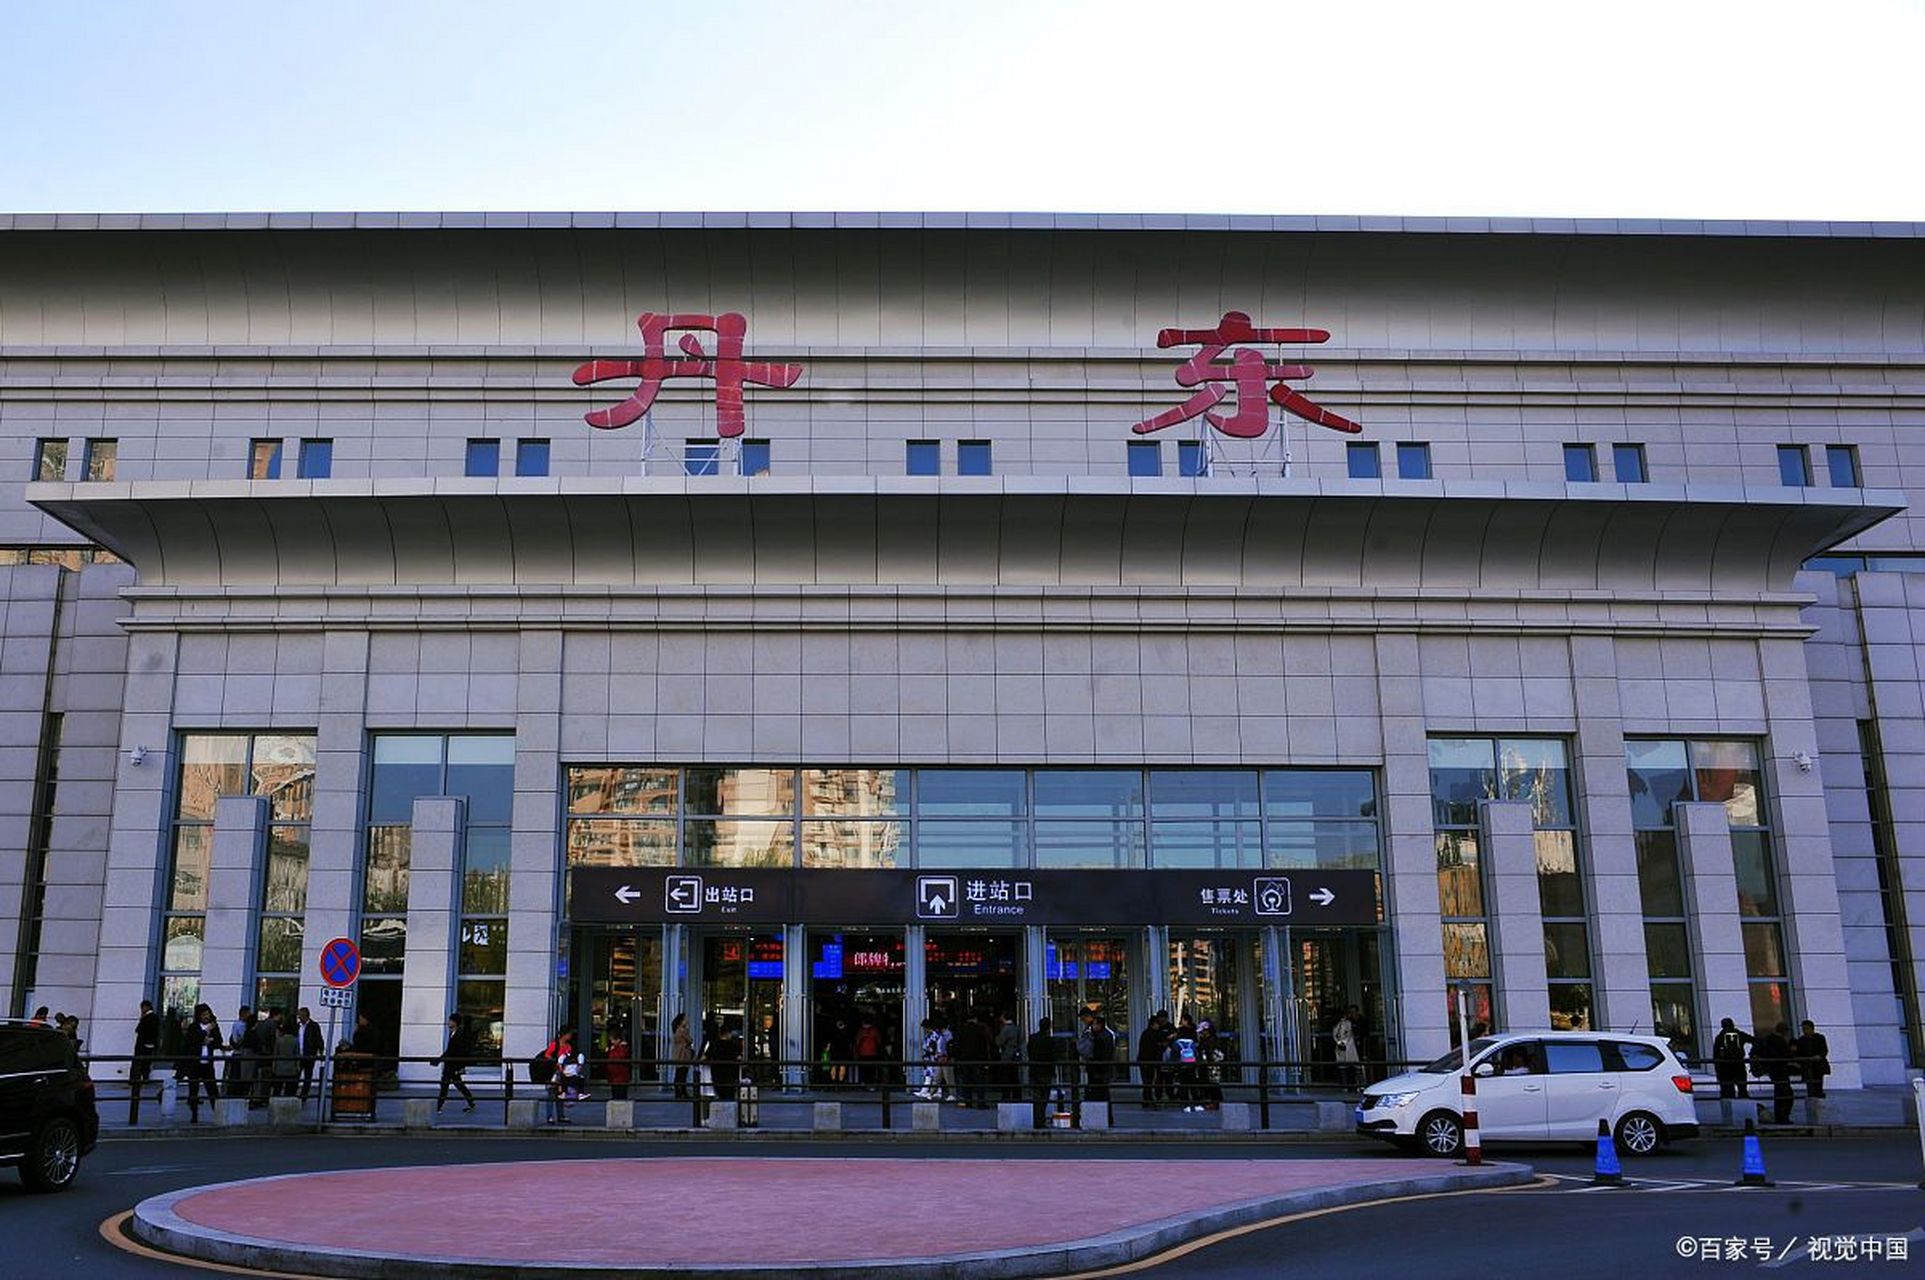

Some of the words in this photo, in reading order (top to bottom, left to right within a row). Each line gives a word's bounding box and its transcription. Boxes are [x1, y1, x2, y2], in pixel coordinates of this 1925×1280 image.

[705, 886, 754, 903] 出站口
[966, 879, 1032, 901] 进站口
[1200, 887, 1249, 904] 售票处
[721, 906, 737, 914] Exit
[974, 904, 1025, 915] Entrance
[1211, 907, 1240, 915] Tickets
